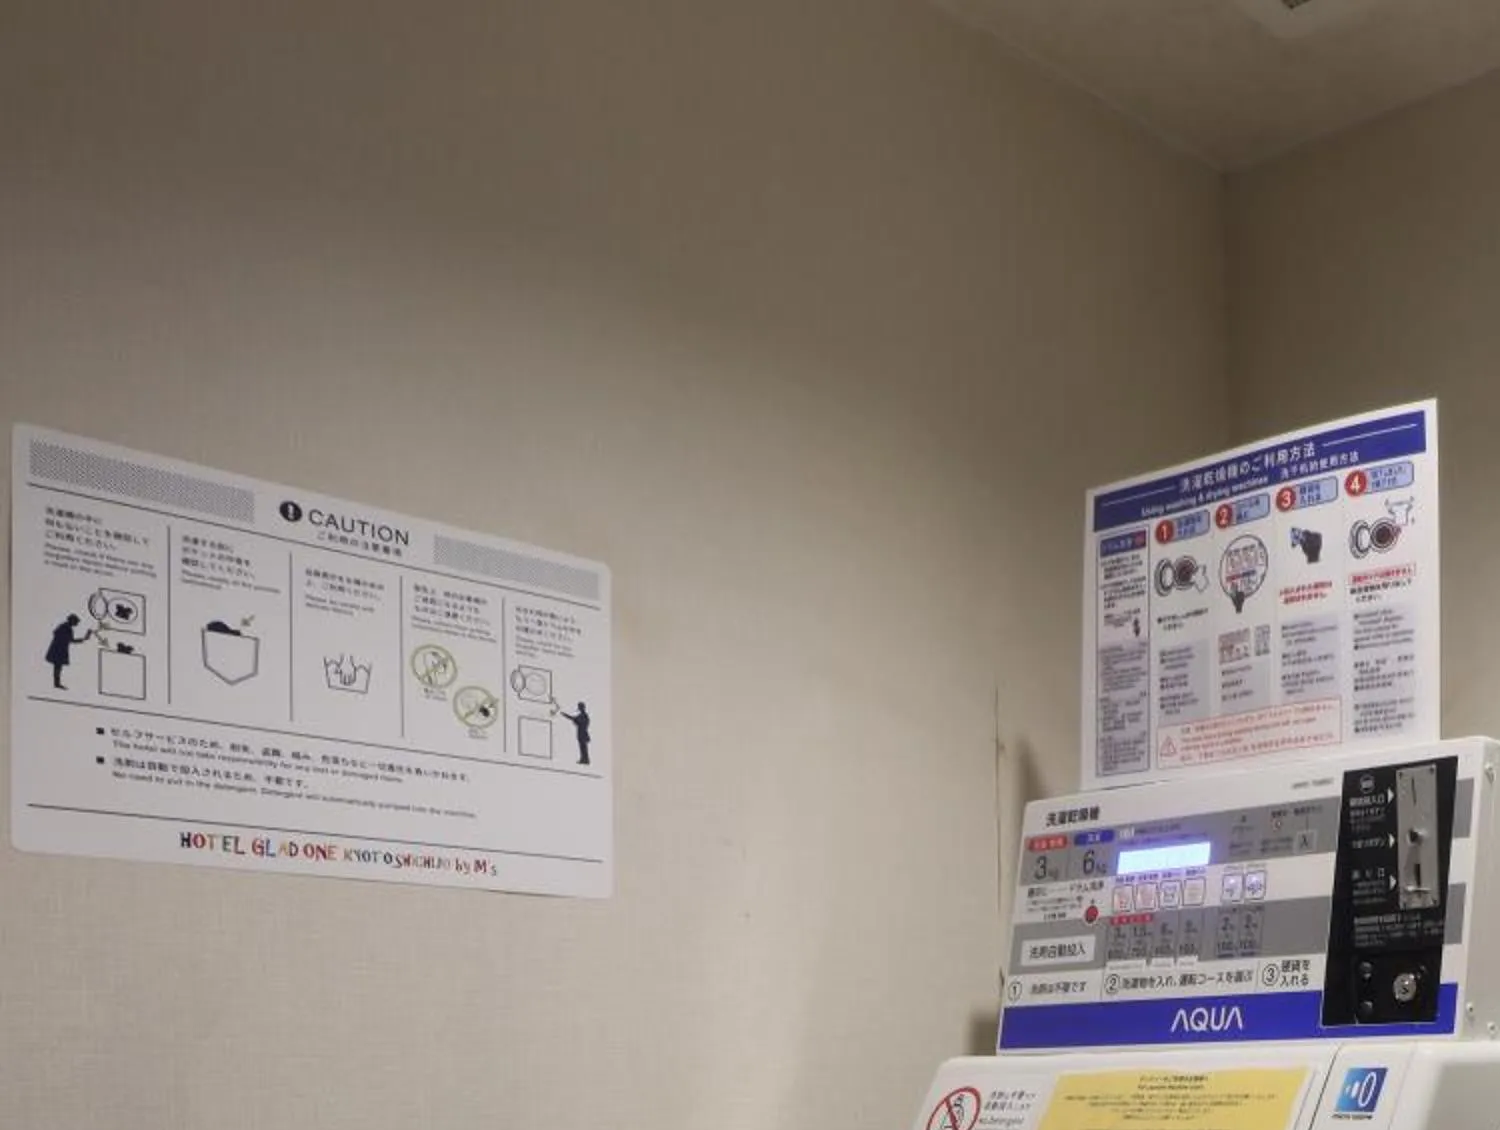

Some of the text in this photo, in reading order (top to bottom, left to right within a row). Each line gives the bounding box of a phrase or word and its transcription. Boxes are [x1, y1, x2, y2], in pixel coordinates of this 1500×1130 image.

[308, 508, 410, 546] CAUTION
[180, 831, 246, 856] HOTEL
[251, 838, 300, 859] GLAD
[302, 842, 338, 862] ONE
[455, 859, 471, 875] by
[1170, 1005, 1245, 1034] AQUA
